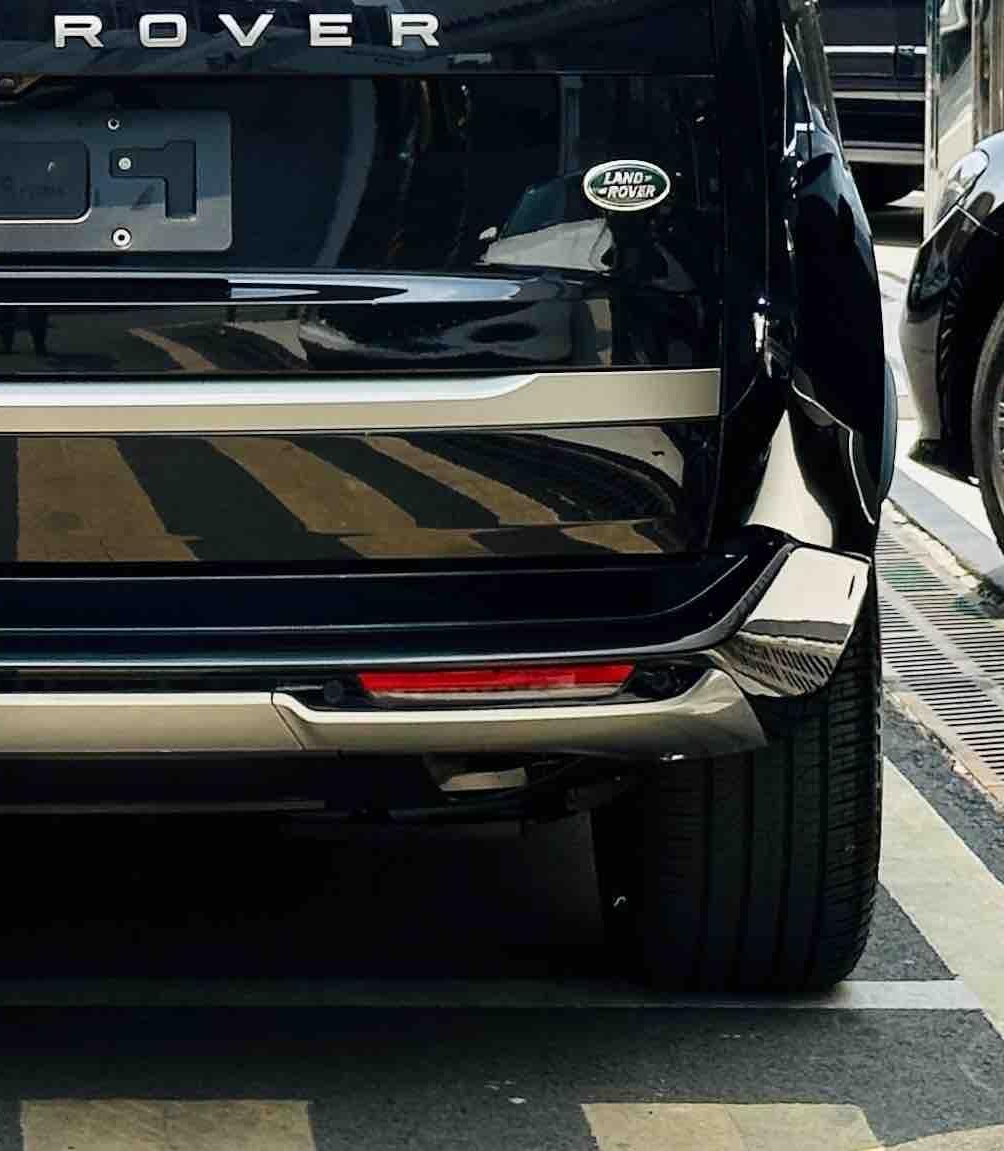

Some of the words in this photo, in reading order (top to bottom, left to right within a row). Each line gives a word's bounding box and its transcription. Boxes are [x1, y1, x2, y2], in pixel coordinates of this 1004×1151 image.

[53, 13, 441, 48] ROVER
[603, 170, 644, 185] LAND
[606, 184, 656, 200] ROVER
